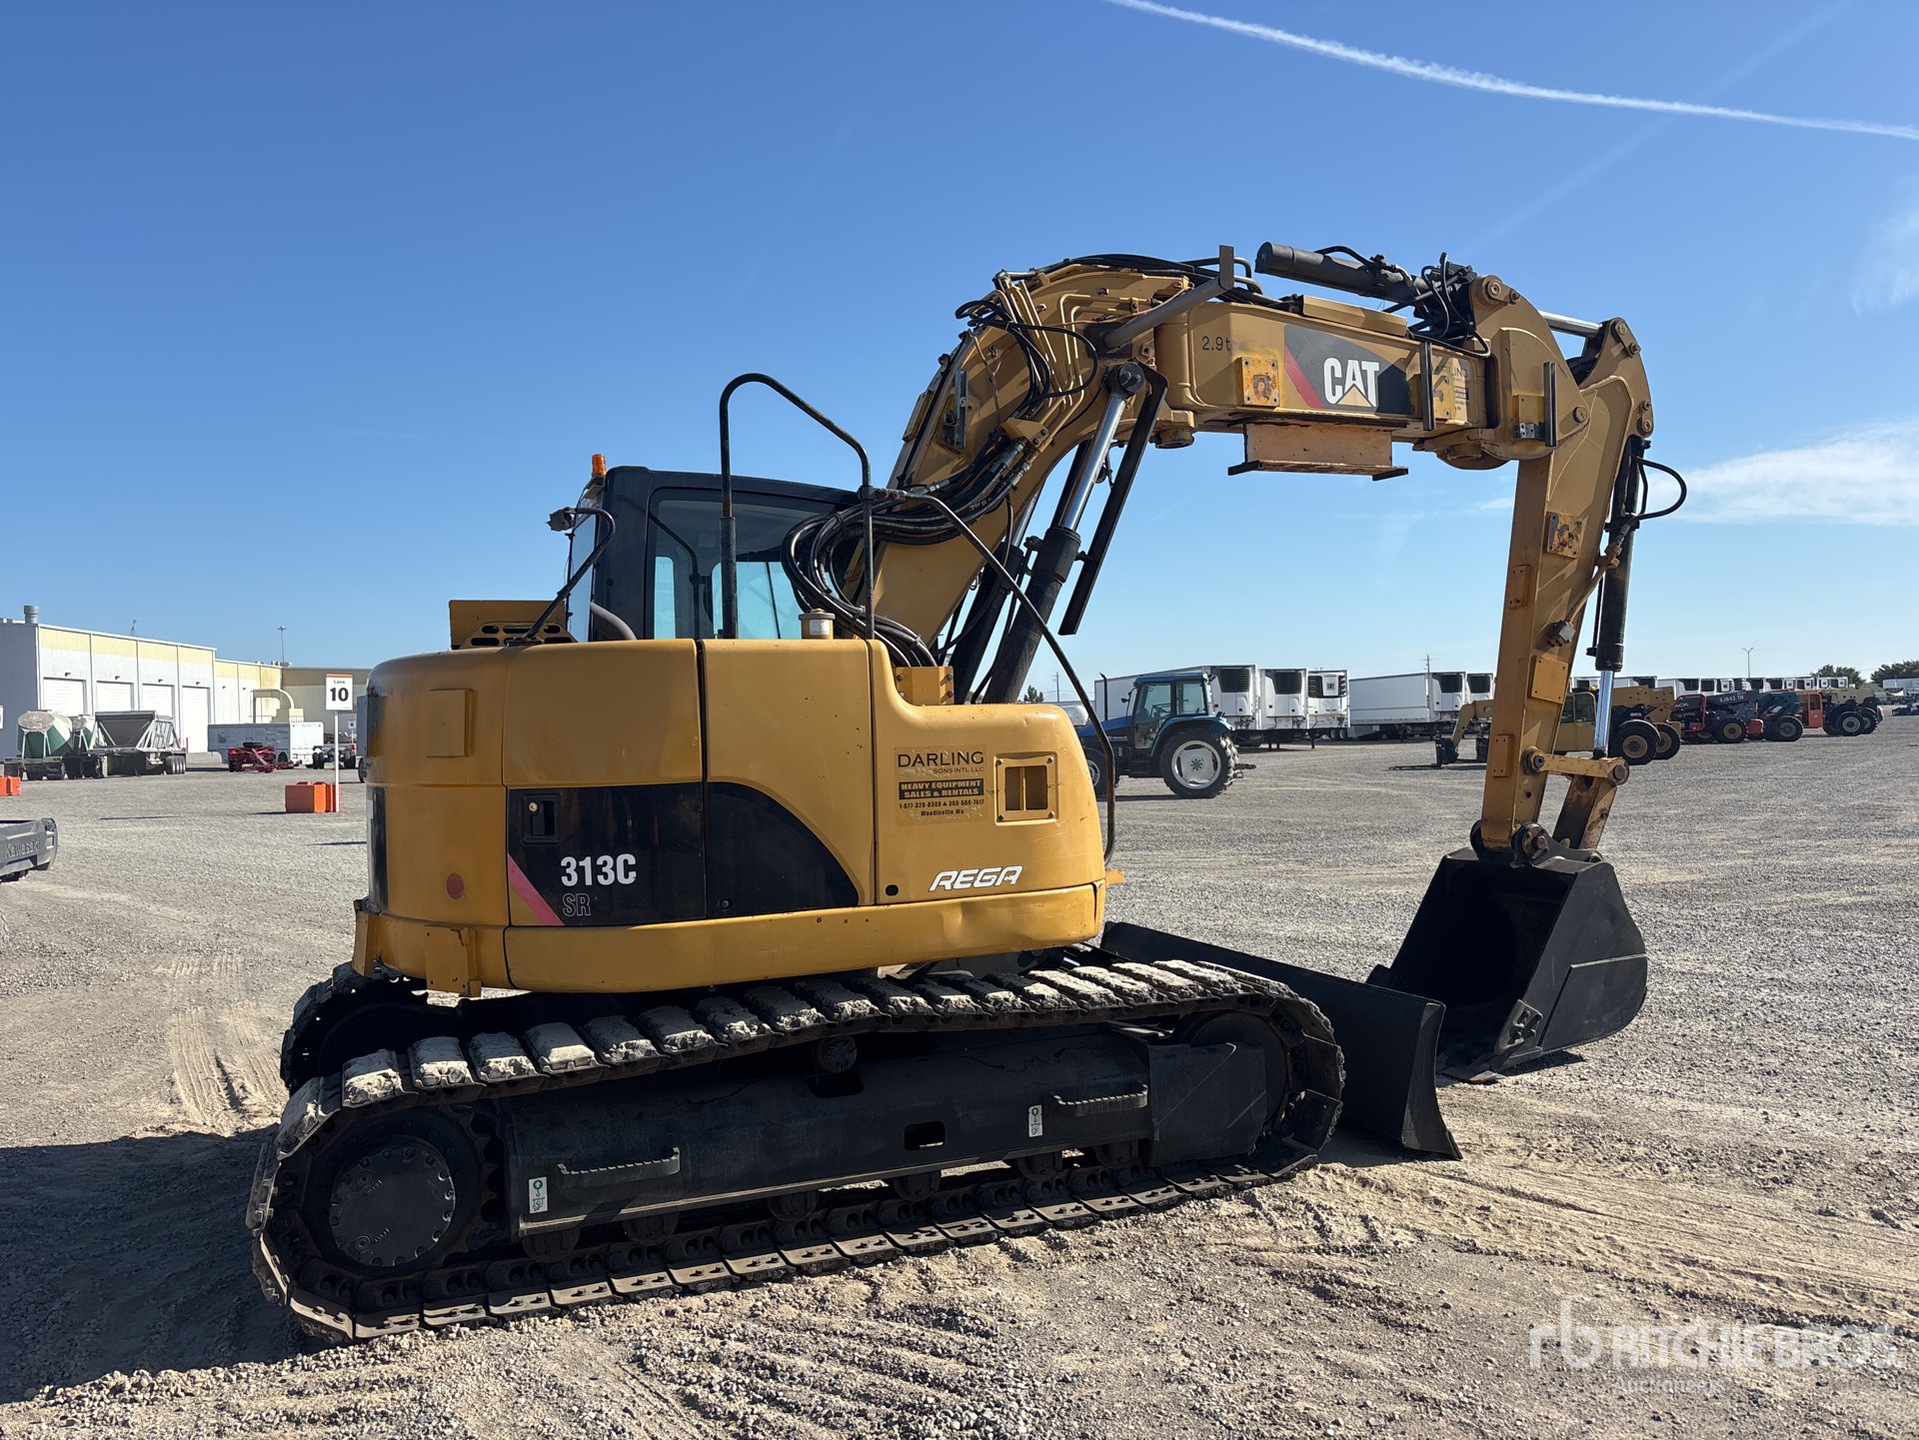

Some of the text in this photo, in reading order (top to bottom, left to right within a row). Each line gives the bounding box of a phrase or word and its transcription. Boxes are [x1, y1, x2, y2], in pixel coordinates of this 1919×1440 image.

[1201, 335, 1232, 351] 2.9t
[1323, 357, 1380, 408] CAT
[329, 687, 349, 702] 10
[897, 751, 984, 768] DARLING
[901, 780, 982, 790] HEAVY EQUIPMENT
[904, 790, 931, 798] SALES
[941, 788, 979, 796] RENTALS
[5, 838, 40, 858] Kawasaki
[560, 853, 637, 887] 313C
[928, 865, 1023, 892] REGA
[562, 893, 591, 917] SR
